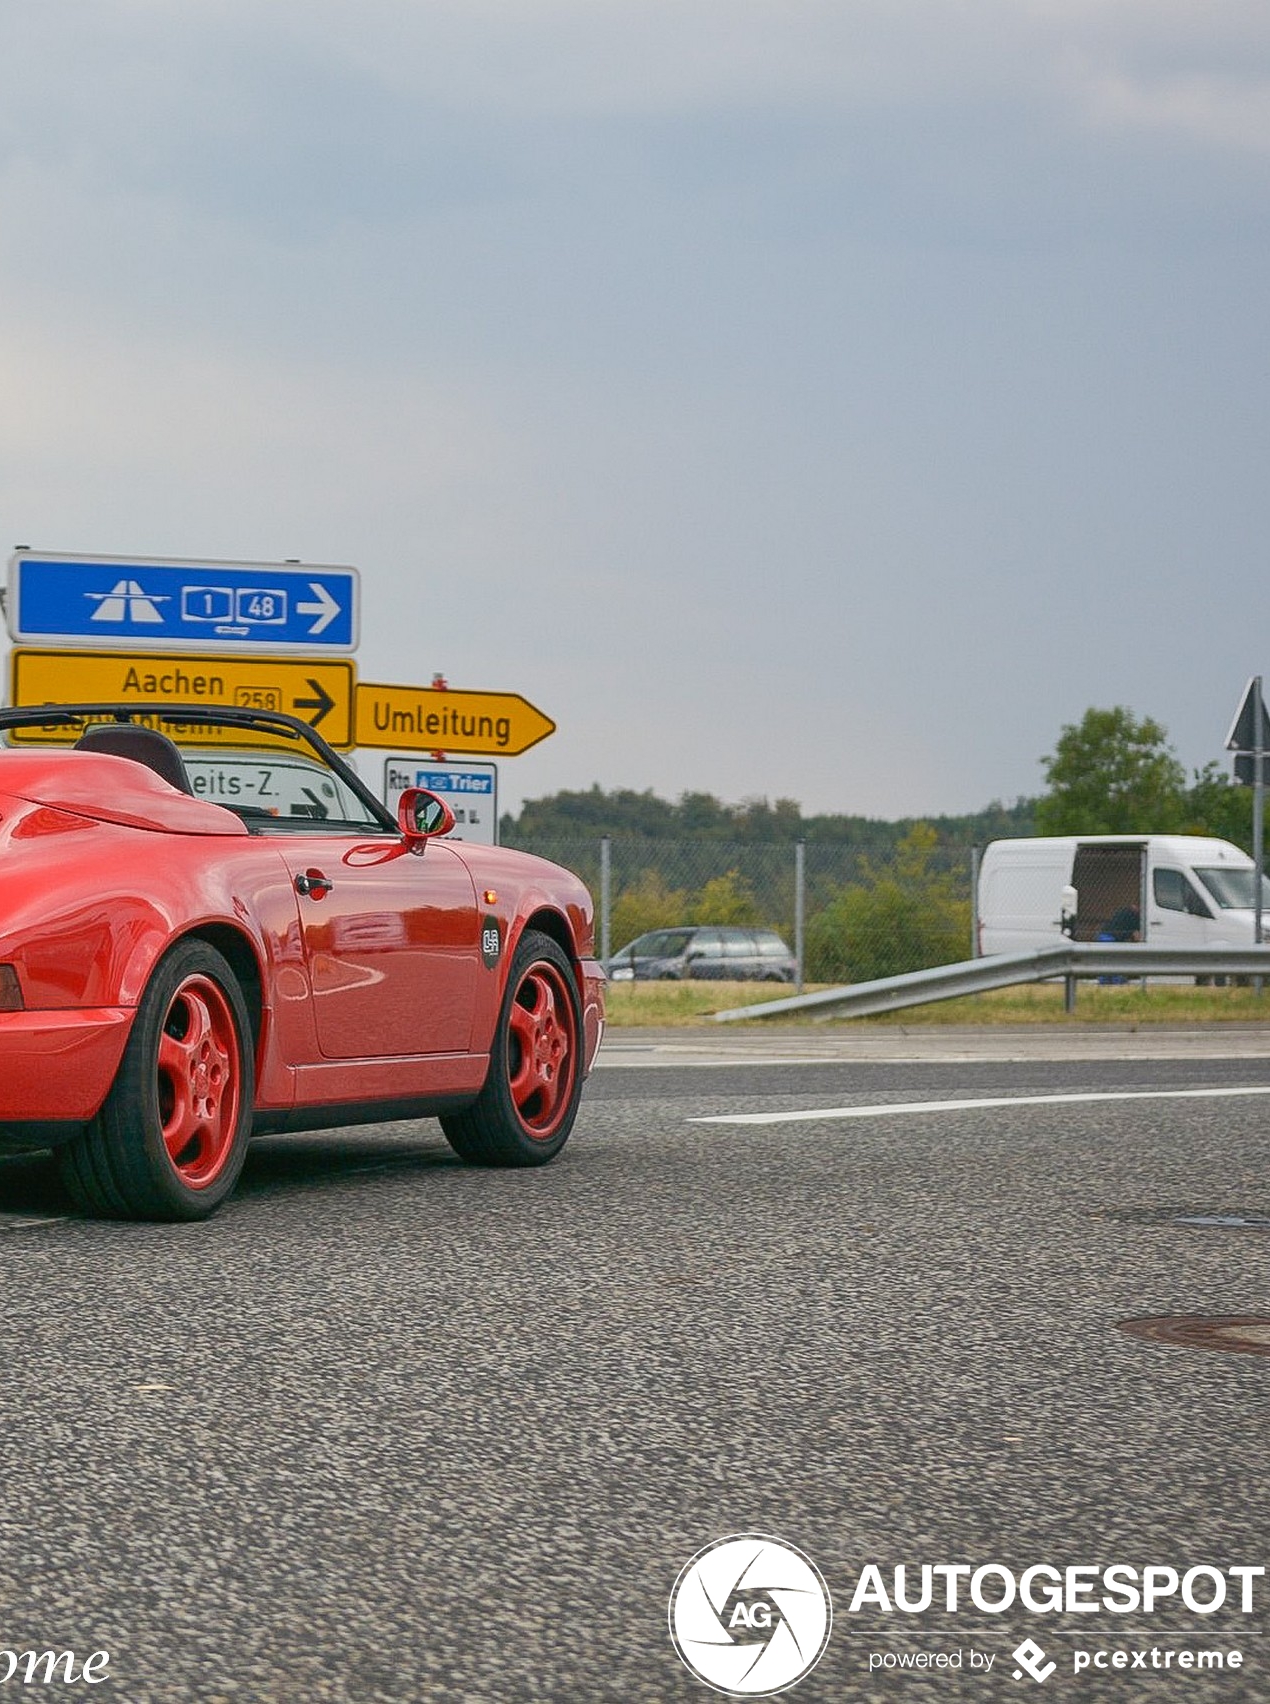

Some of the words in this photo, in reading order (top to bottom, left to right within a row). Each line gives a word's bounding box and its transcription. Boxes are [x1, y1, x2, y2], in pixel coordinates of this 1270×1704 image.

[204, 594, 213, 615] 1
[248, 596, 275, 618] 48
[122, 667, 224, 696] Aachen
[240, 692, 276, 711] 258
[374, 701, 511, 747] Umleitung
[193, 769, 280, 796] eits-Z.
[449, 774, 489, 791] Trier
